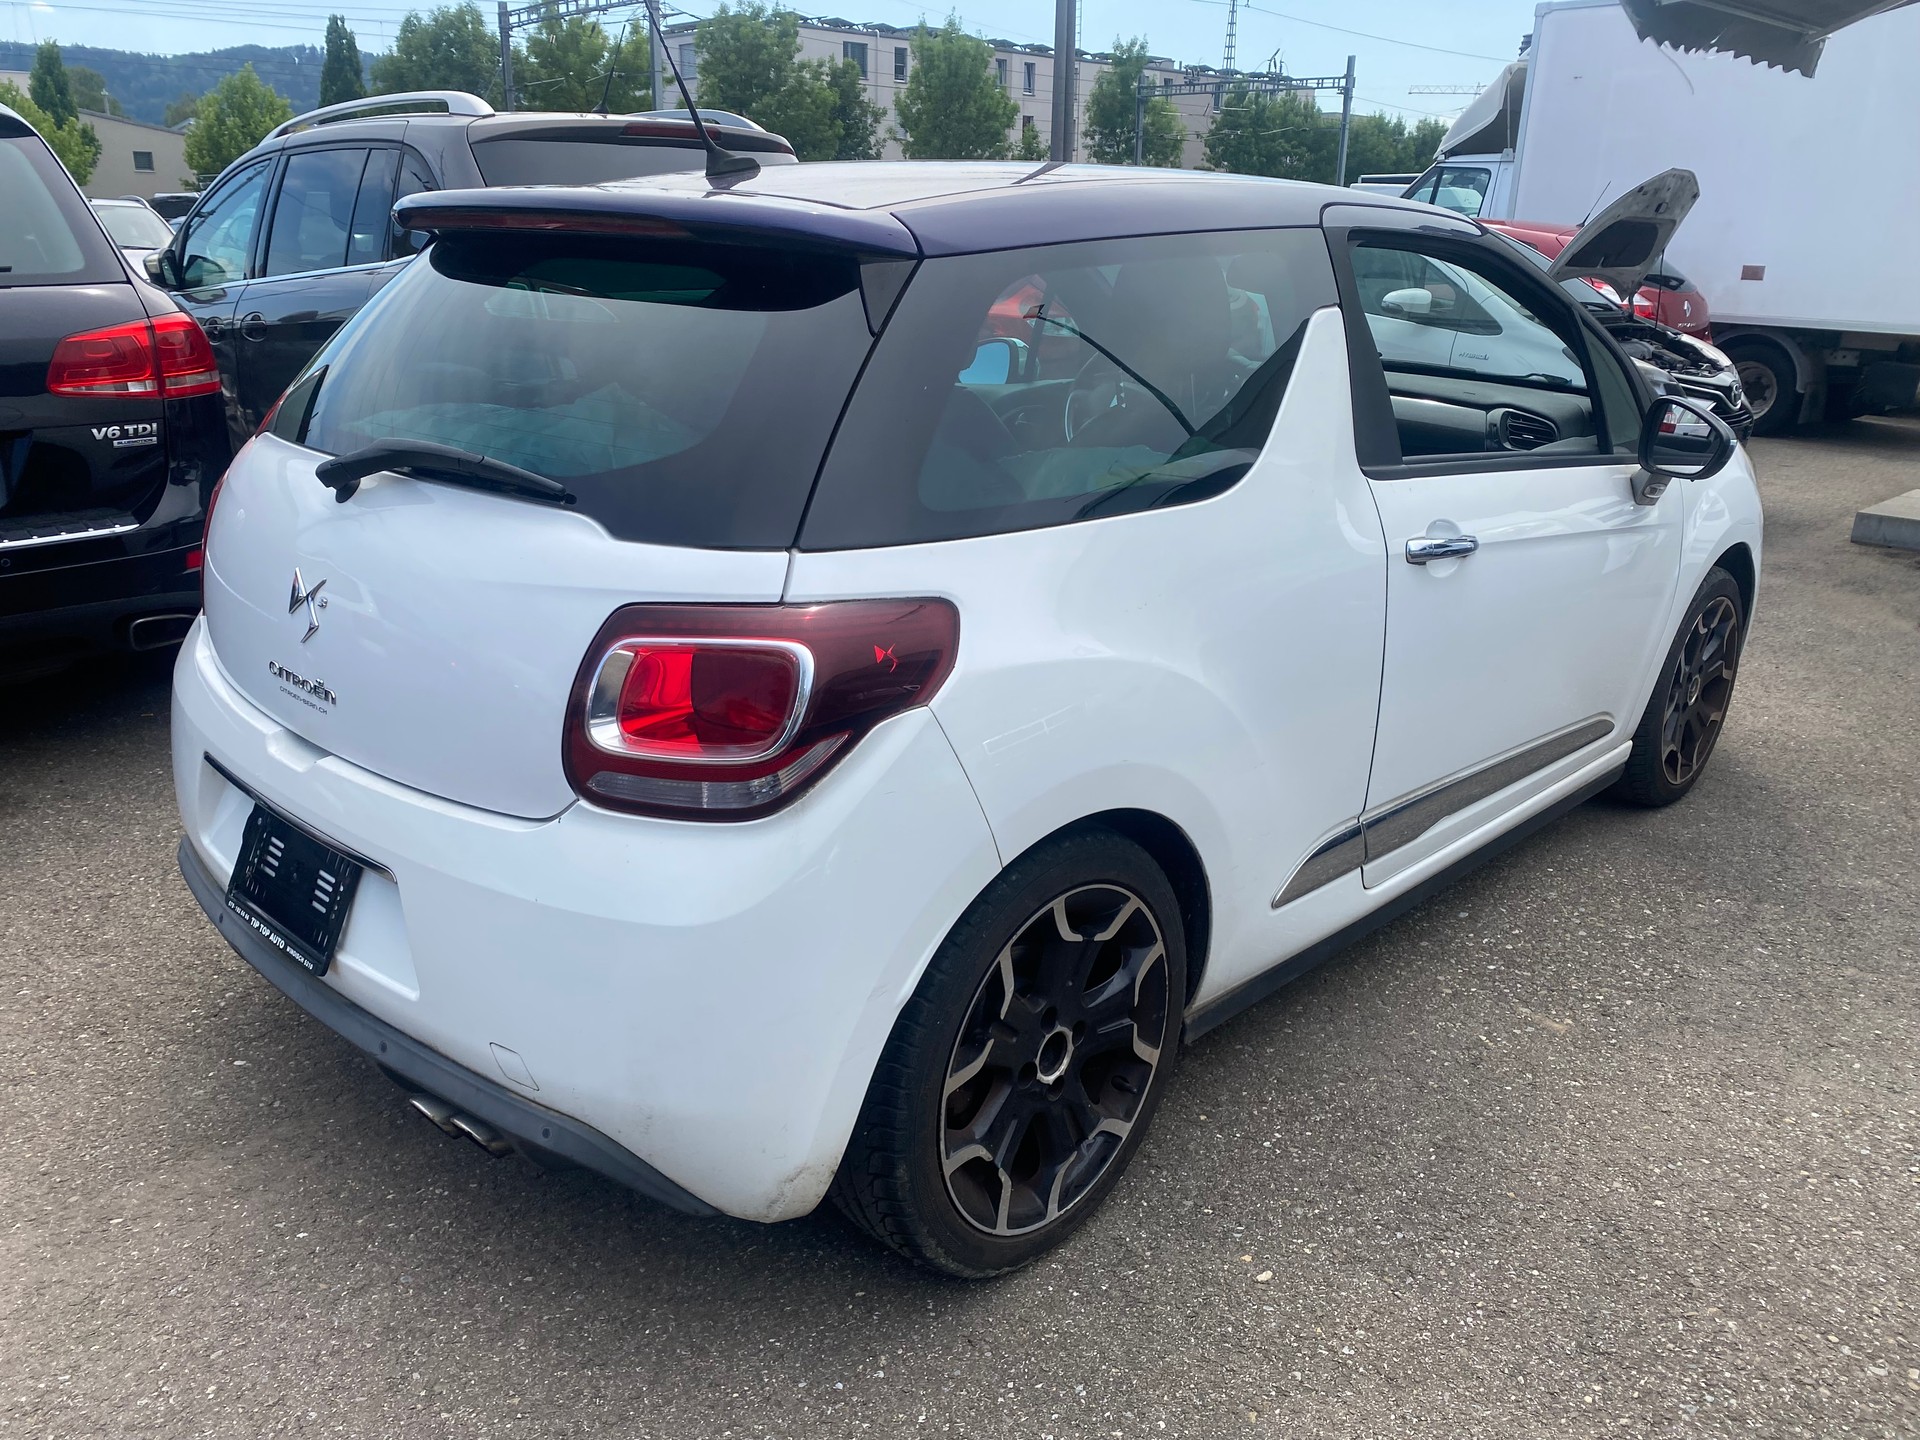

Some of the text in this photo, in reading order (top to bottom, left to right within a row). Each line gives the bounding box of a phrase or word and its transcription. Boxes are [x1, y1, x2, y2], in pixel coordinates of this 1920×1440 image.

[91, 423, 157, 440] V6 TDI
[250, 917, 260, 929] TIP
[259, 923, 271, 937] TOP
[269, 933, 285, 949] AUTO
